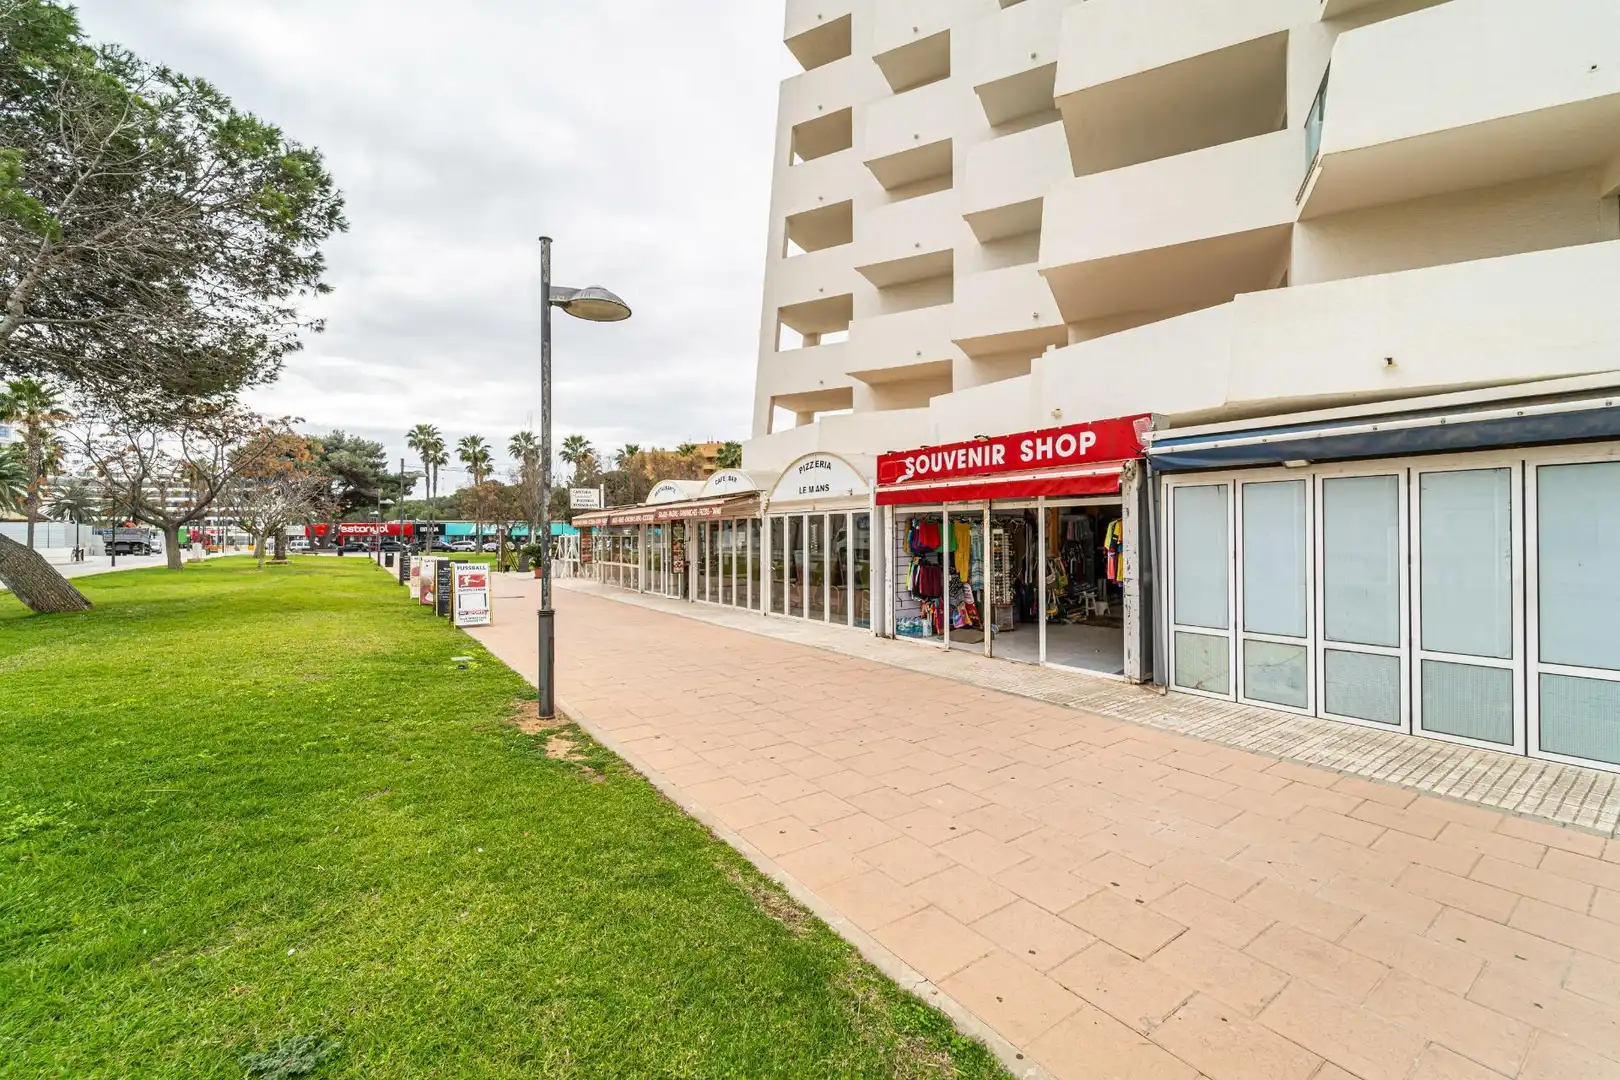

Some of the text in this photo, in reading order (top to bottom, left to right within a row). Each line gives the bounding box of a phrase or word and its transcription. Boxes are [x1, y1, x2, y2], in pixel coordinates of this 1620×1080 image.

[904, 430, 1097, 475] SOUVENIR SHOP
[798, 459, 832, 474] PIZZERIA
[728, 475, 738, 483] BAR
[798, 484, 830, 494] LE MANS
